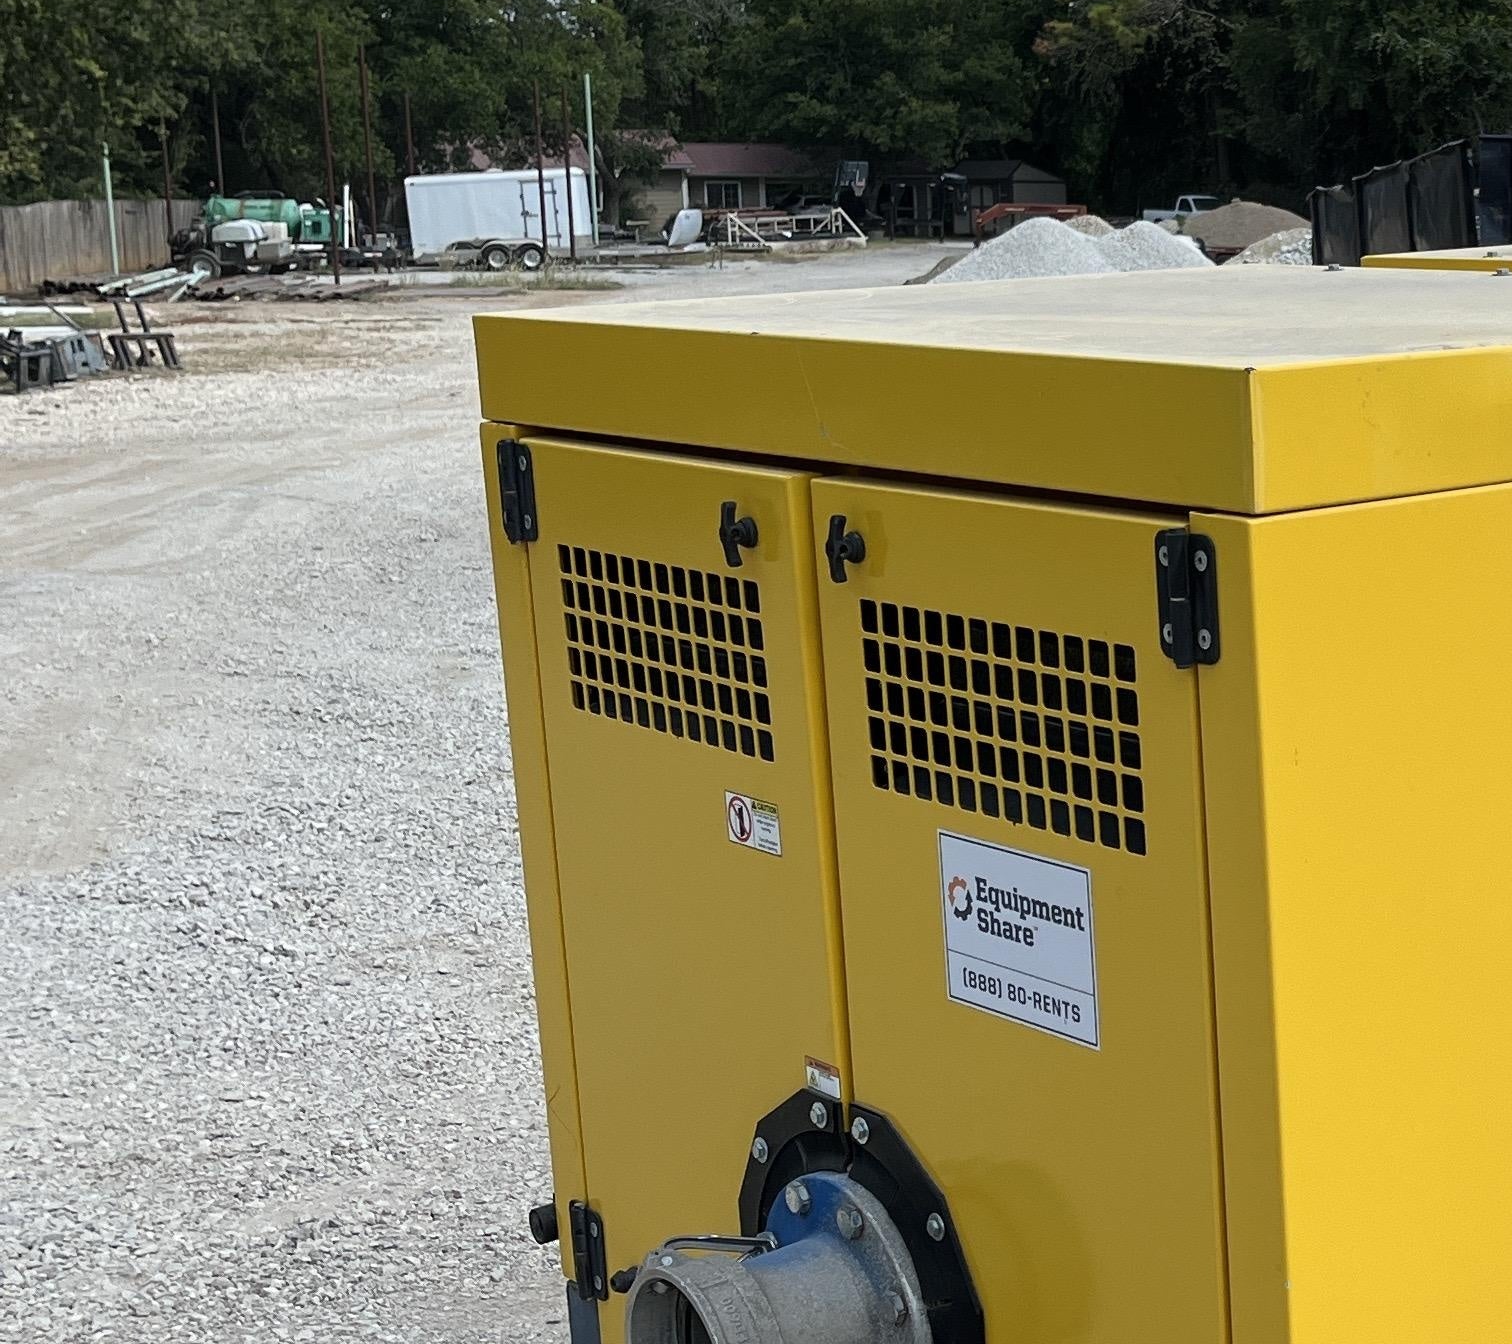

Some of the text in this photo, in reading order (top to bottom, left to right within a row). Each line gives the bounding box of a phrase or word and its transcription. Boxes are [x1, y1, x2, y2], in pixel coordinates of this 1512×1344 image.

[975, 877, 1085, 931] Equipment
[977, 908, 1035, 947] Share
[962, 966, 1081, 1023] (888) 80-RENTS
